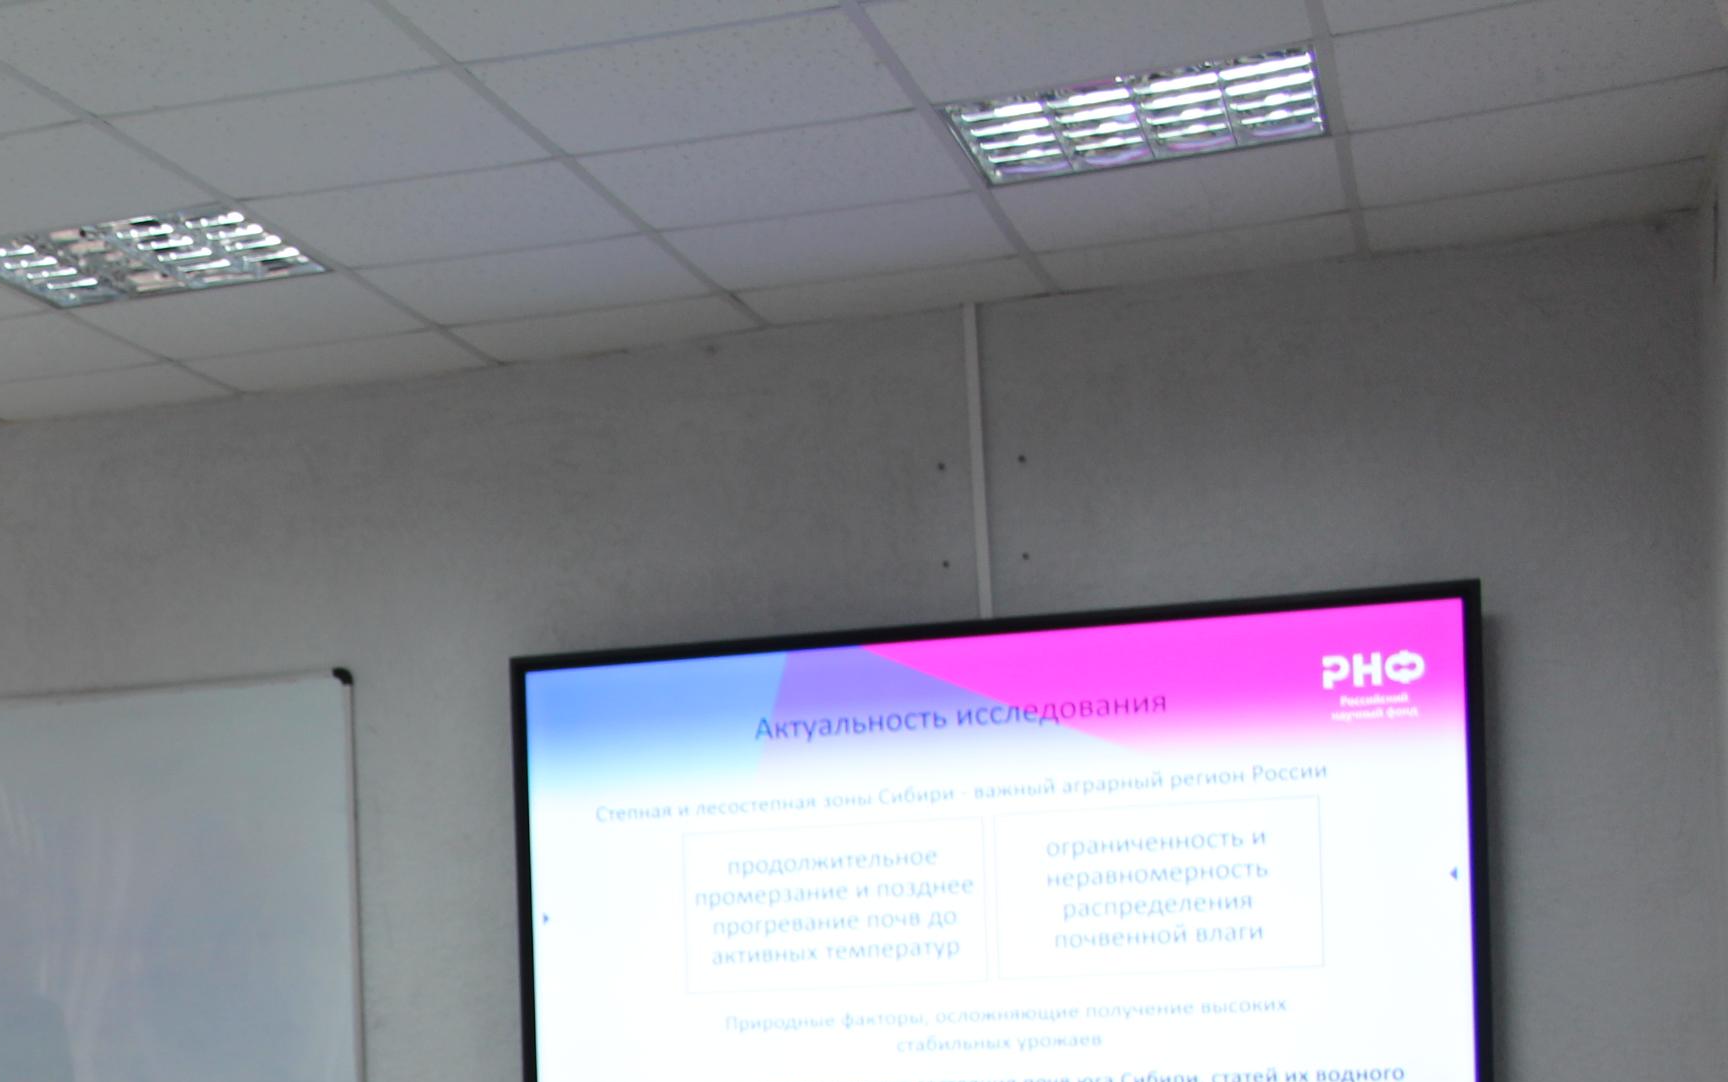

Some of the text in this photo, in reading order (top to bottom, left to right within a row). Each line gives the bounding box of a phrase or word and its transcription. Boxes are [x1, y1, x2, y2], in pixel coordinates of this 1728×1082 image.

[1322, 650, 1425, 690] РНФ
[754, 693, 1167, 743] Актуальность исследования
[595, 803, 672, 823] Степная
[679, 803, 690, 817] и
[695, 797, 817, 817] лесостепная
[823, 793, 872, 809] зоны
[878, 784, 955, 806] Сибири
[974, 778, 1056, 799] важный
[1062, 770, 1164, 796] аграрный
[1171, 768, 1245, 790] регион
[1252, 763, 1328, 783] России
[1045, 829, 1268, 860] ограниченность и
[727, 848, 939, 878] продолжительное
[1046, 861, 1271, 890] неравномерность
[695, 878, 975, 909] промерзание и позднее
[1063, 893, 1254, 921] распределения
[713, 909, 959, 938] прогревание почв до
[1055, 923, 1265, 950] почвенной влаги
[712, 938, 961, 965] активных температур
[724, 998, 1288, 1034] Природные факторы, осложняющие получение высоких
[896, 1033, 1104, 1055] стабильных урожаев
